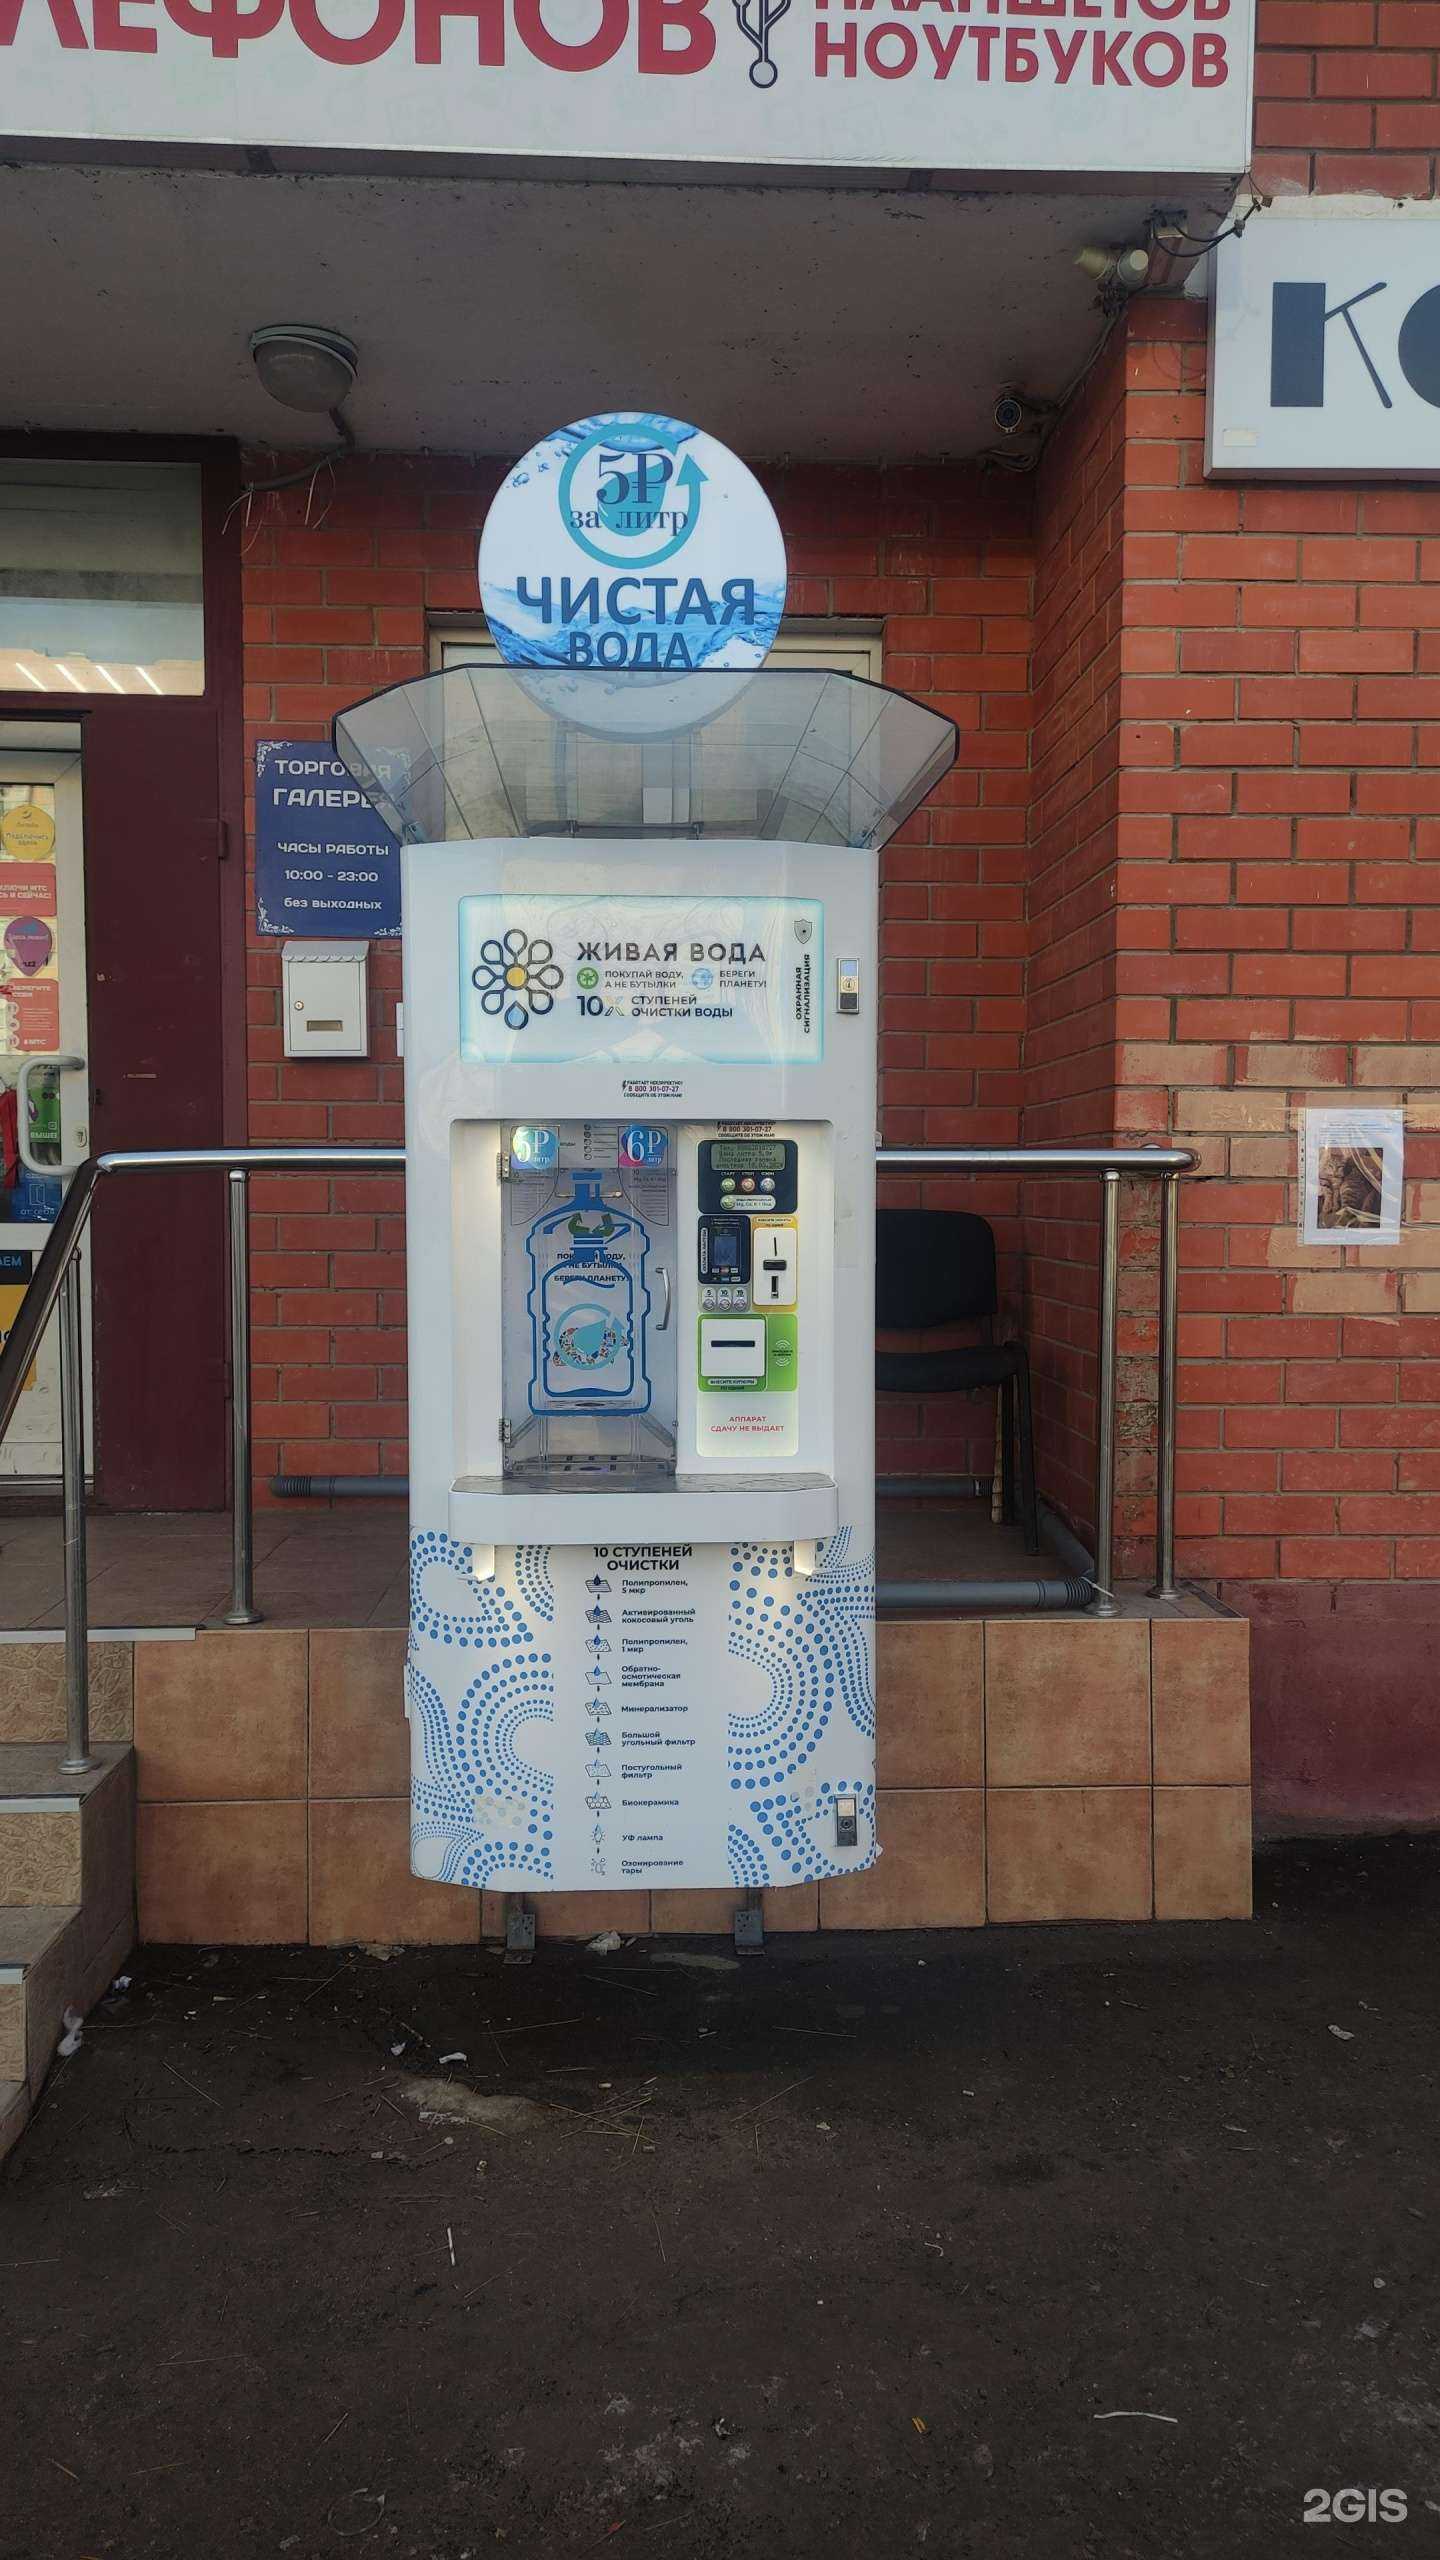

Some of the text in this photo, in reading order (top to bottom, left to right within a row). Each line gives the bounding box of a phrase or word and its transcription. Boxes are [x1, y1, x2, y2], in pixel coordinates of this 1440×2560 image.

[814, 22, 1229, 88] НОУТБУКОВ
[570, 510, 688, 536] за литр
[516, 576, 755, 626] ЧИСТАЯ
[569, 631, 694, 669] ВОДА
[278, 842, 389, 856] ЧАСЫ РАБОТЫ
[284, 870, 323, 881] 10:00
[337, 871, 379, 882] 23:00
[284, 897, 382, 910] без выходных
[577, 942, 767, 965] ЖИВАЯ ВОДА
[605, 970, 684, 980] ПОКУПАЙ ВОДУ,
[631, 981, 677, 989] БУТЫЛКИ
[719, 980, 767, 988] ПЛАНЕТУ!
[631, 995, 697, 1005] СТУПЕНЕЙ
[632, 1007, 733, 1018] ОЧИСТКИ ВОДЫ
[593, 1545, 692, 1557] 10 СТУПЕНЕЙ
[607, 1560, 679, 1570] ОЧИСТКИ
[622, 1580, 688, 1588] Полипропилен,
[622, 1639, 688, 1647] Полипропилен,
